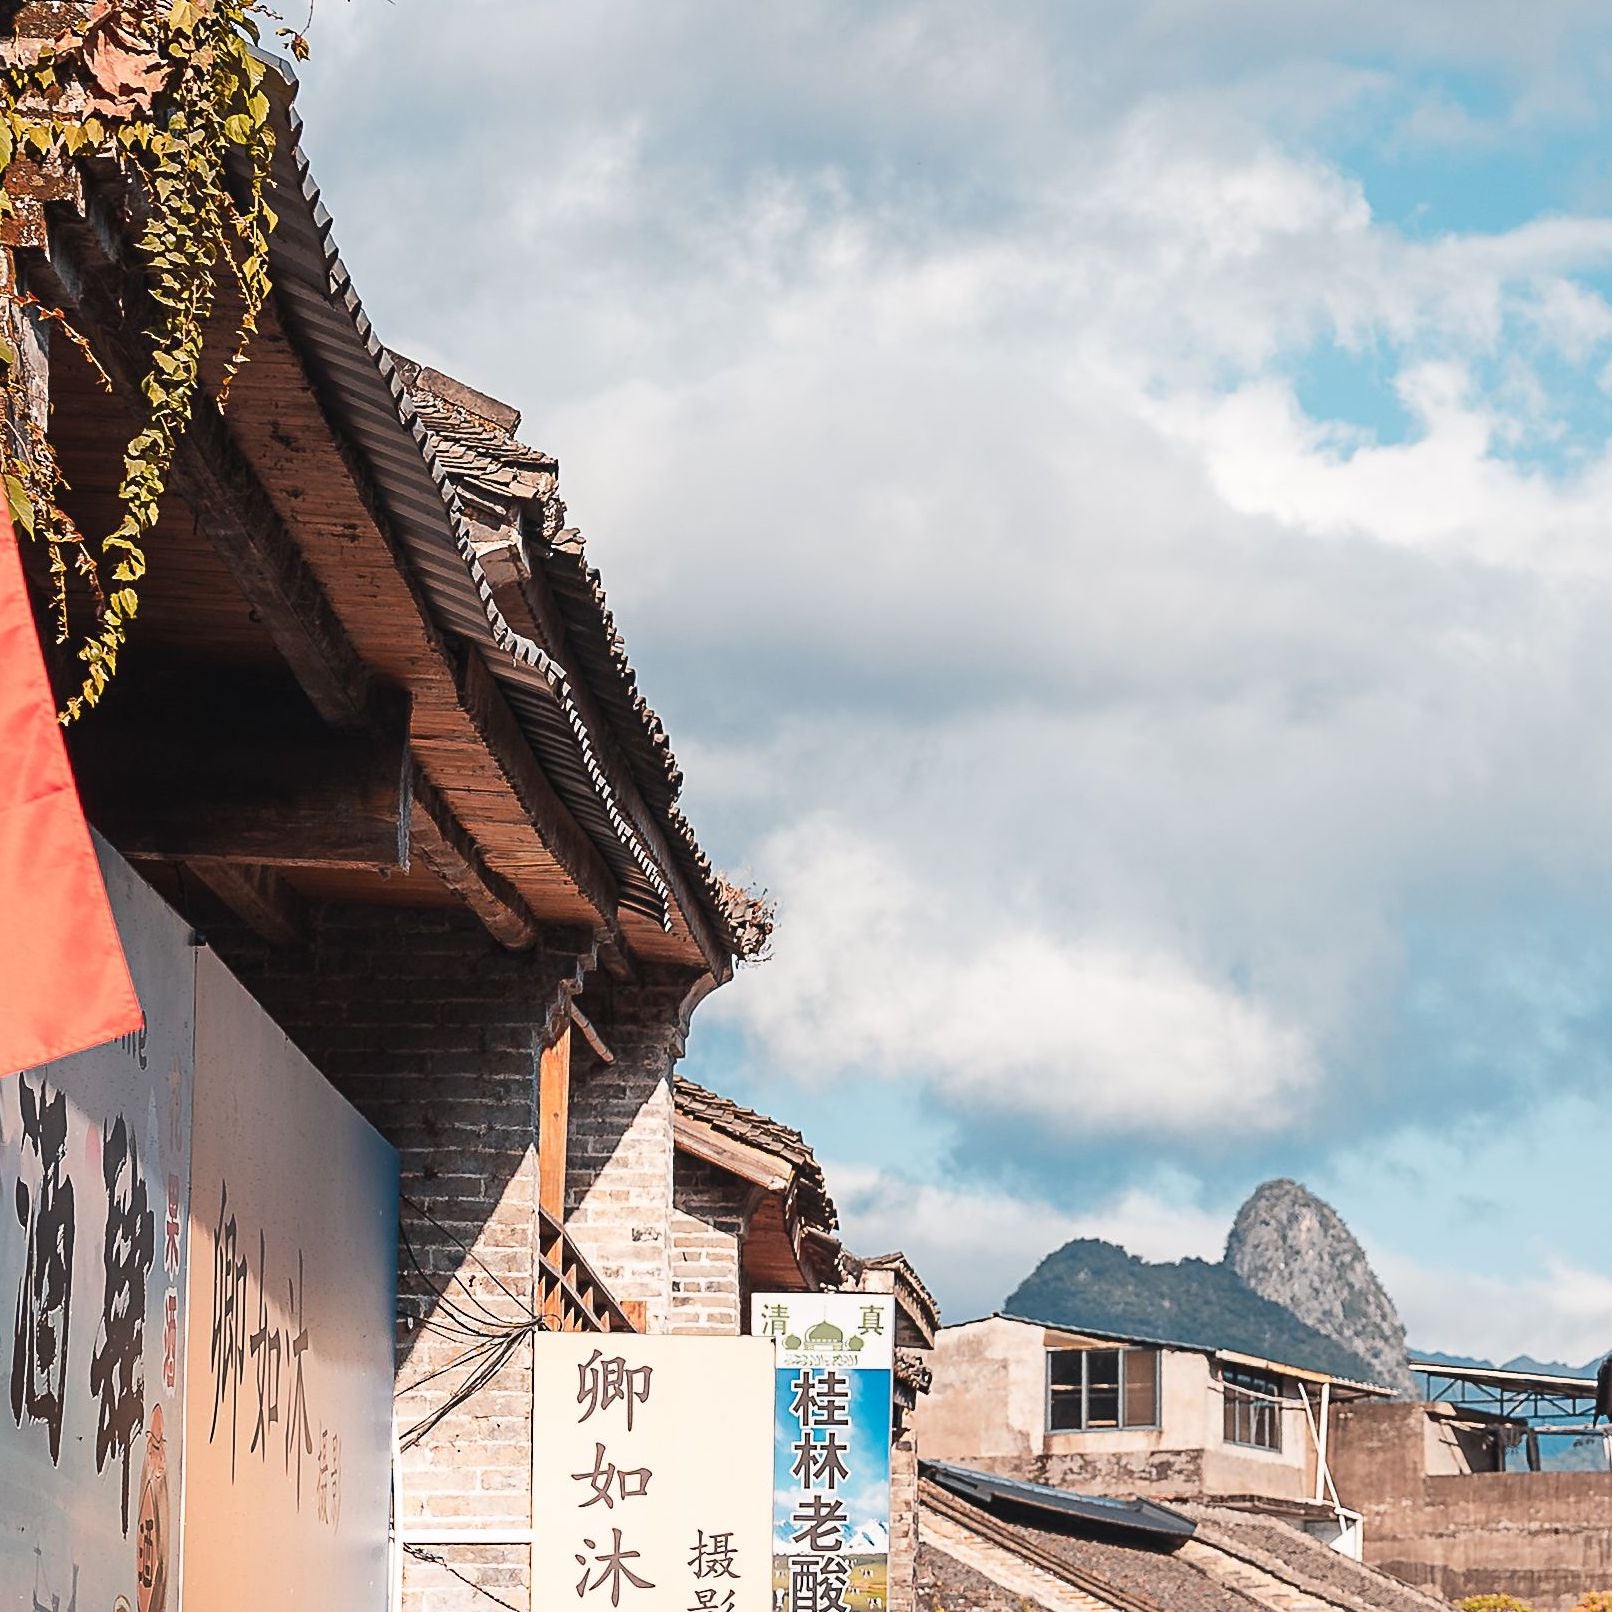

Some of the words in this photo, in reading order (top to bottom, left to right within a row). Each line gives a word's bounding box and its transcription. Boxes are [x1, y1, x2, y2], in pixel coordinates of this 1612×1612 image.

[209, 1178, 313, 1513] 卿如沐
[571, 1347, 656, 1608] 卿如沐
